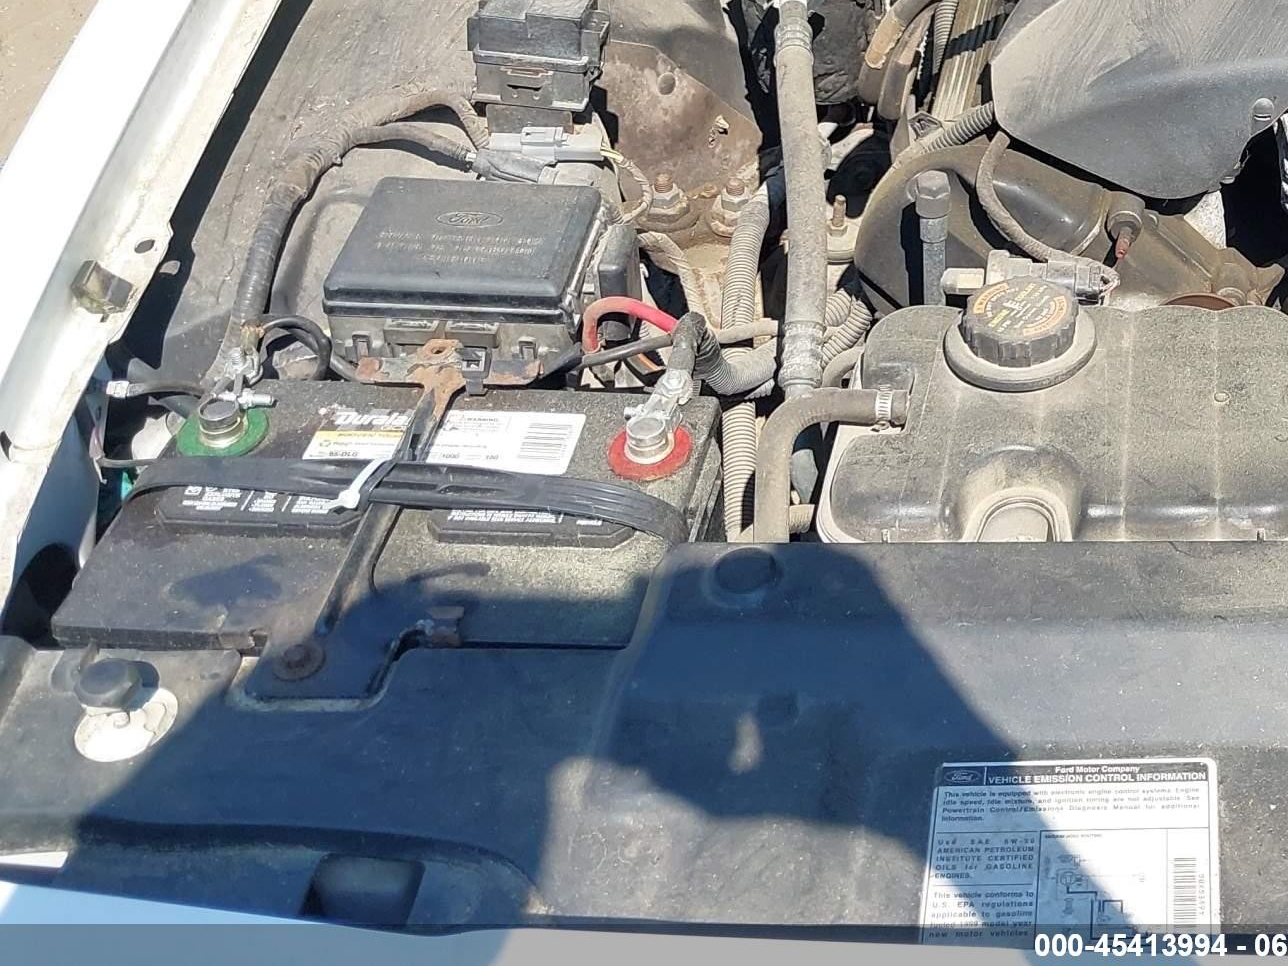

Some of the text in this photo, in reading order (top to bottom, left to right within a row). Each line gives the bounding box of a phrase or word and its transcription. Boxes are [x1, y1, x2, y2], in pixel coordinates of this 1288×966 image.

[1101, 766, 1140, 774] Company
[989, 772, 1207, 784] VEHICLE EMISSION CONTROL INFORMATION
[957, 900, 975, 908] EPA
[981, 900, 1034, 909] regulations
